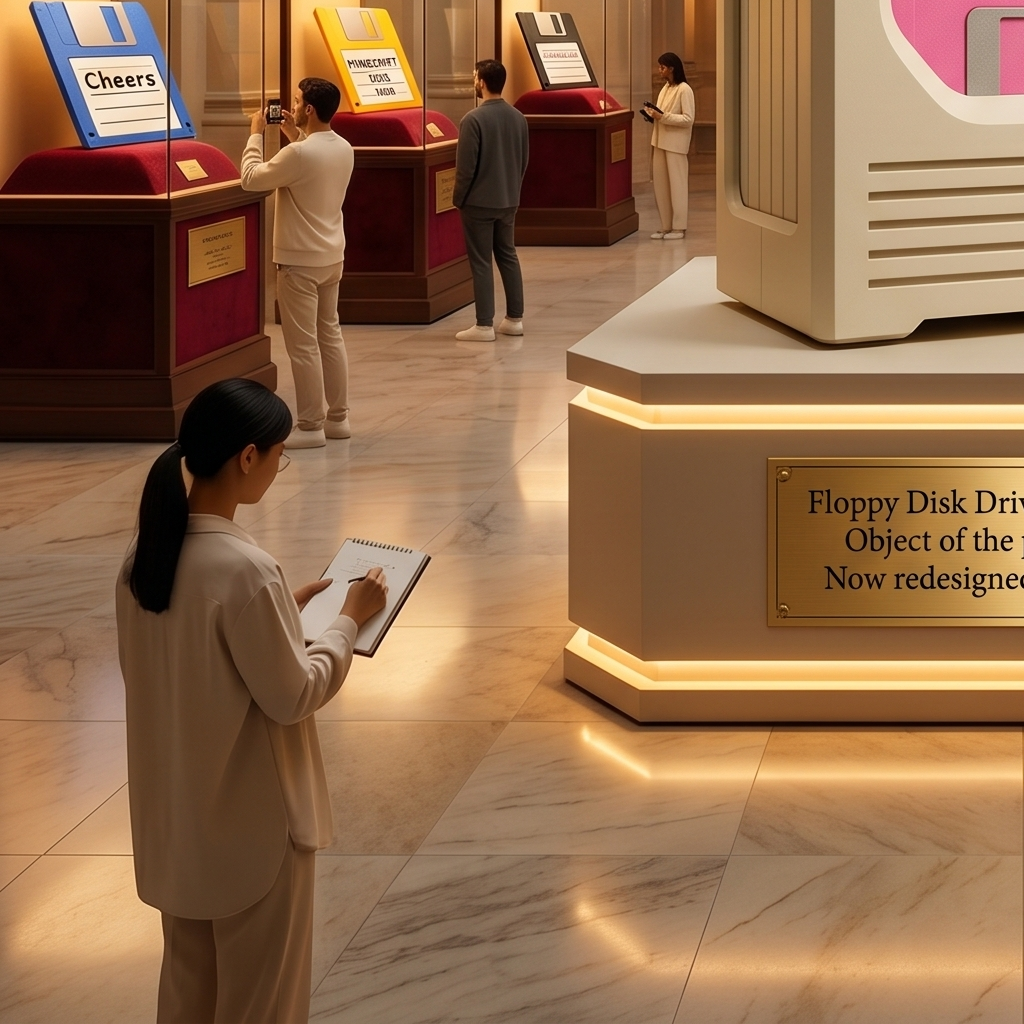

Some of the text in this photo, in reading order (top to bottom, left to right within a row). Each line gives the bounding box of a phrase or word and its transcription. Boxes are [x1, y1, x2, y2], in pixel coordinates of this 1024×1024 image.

[84, 70, 156, 90] Cheers
[807, 489, 901, 522] Floppy
[906, 489, 968, 515] Disk
[844, 527, 932, 560] Object
[939, 526, 969, 553] of
[972, 527, 1014, 553] the
[823, 565, 888, 592] Now
